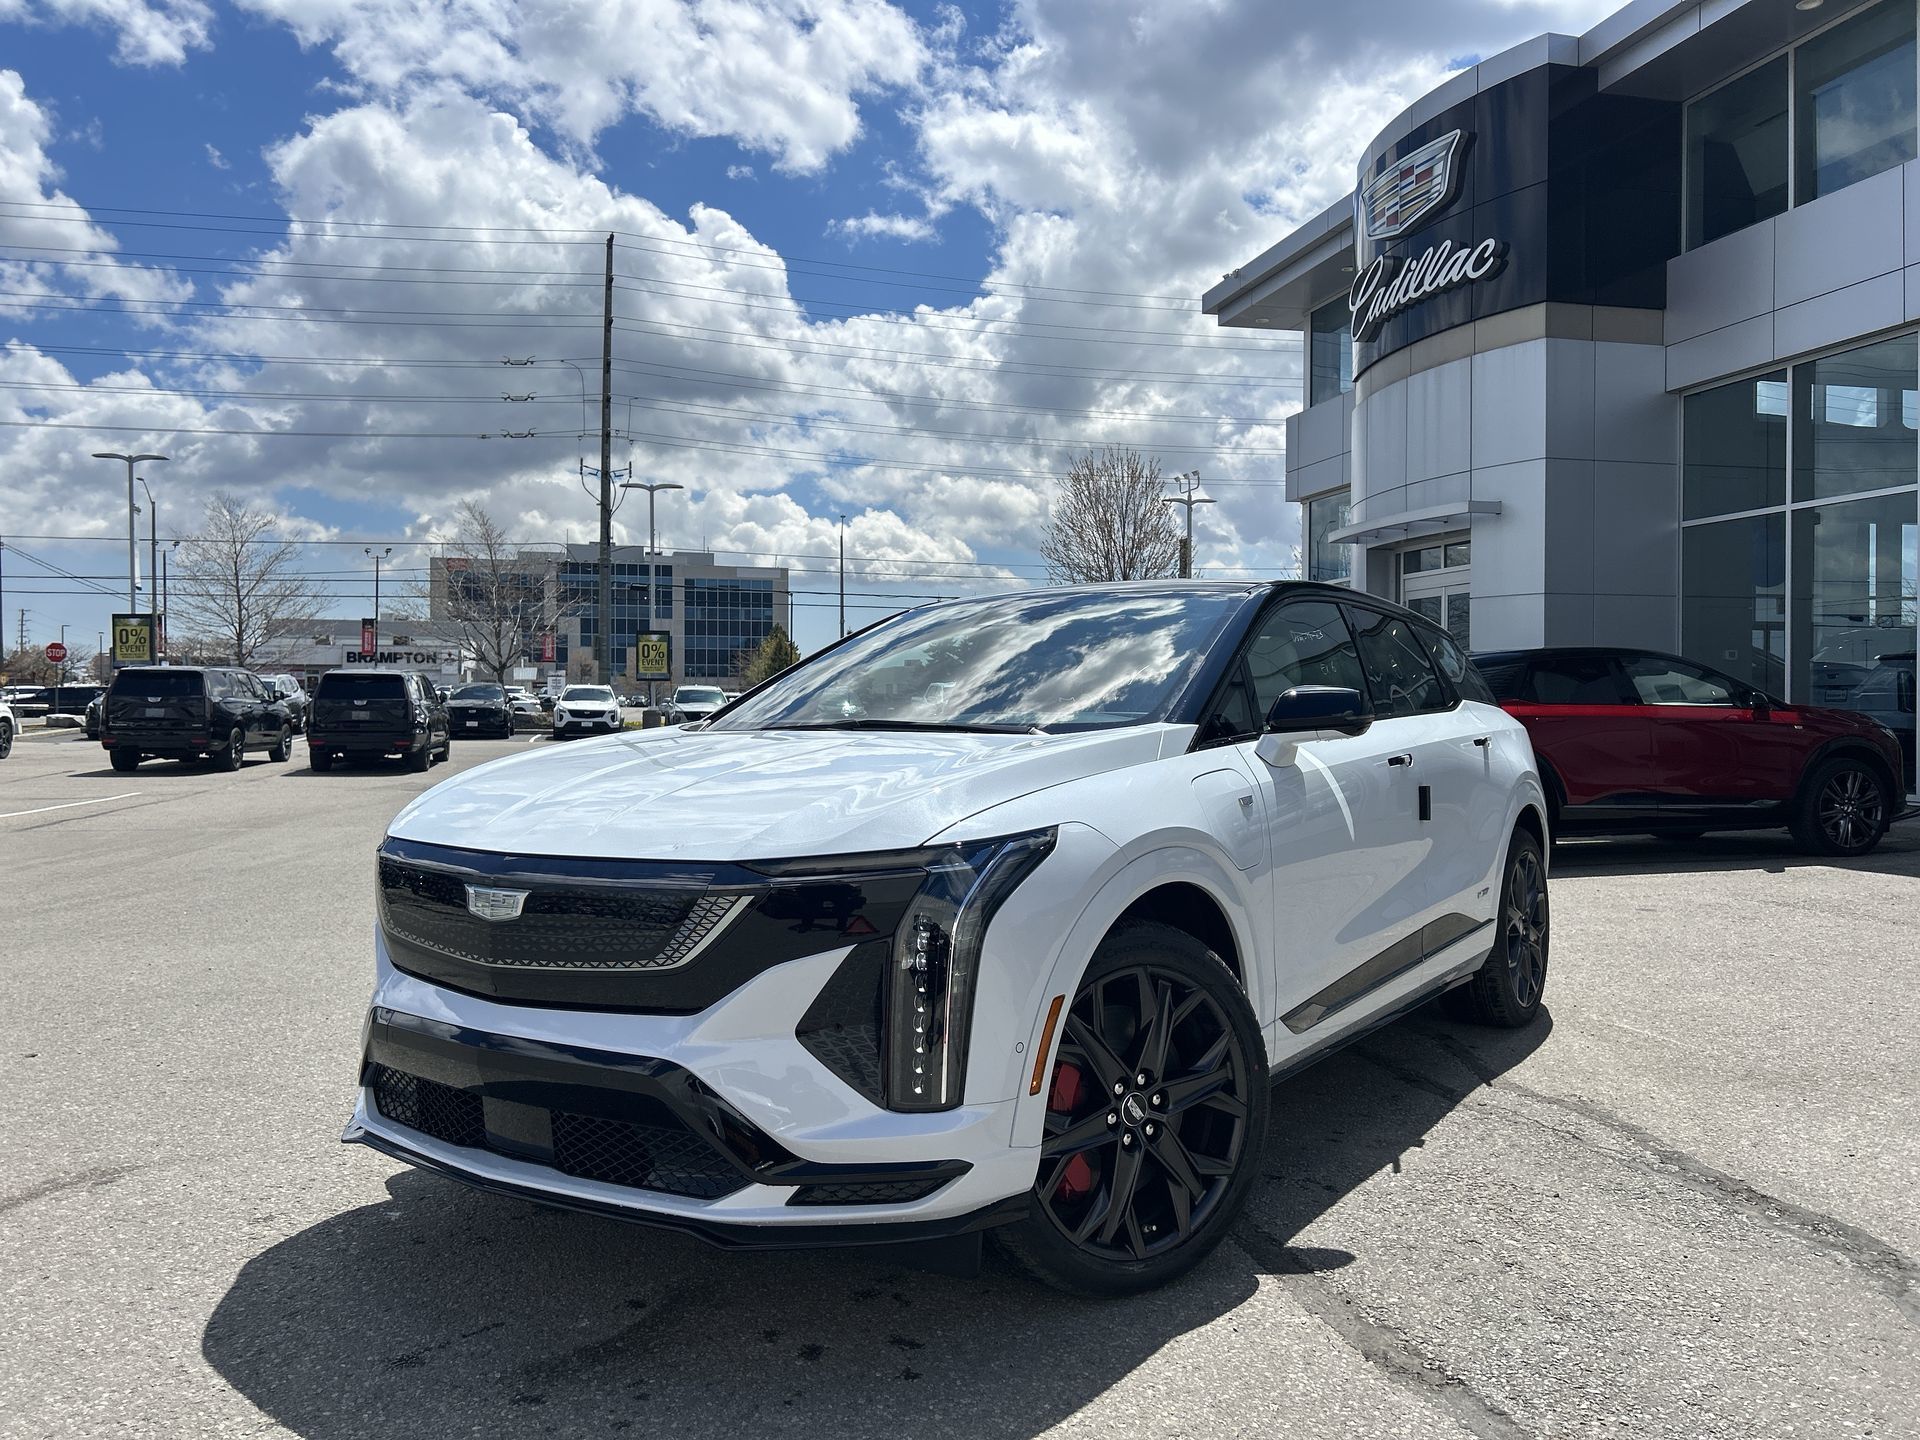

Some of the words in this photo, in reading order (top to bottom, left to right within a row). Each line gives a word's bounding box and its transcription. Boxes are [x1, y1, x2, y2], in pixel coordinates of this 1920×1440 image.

[1349, 238, 1496, 342] Cadillac
[119, 628, 147, 645] 0%
[47, 648, 66, 657] STOP
[119, 645, 146, 653] EVENT
[642, 643, 665, 659] 0%
[641, 658, 665, 666] EVENT
